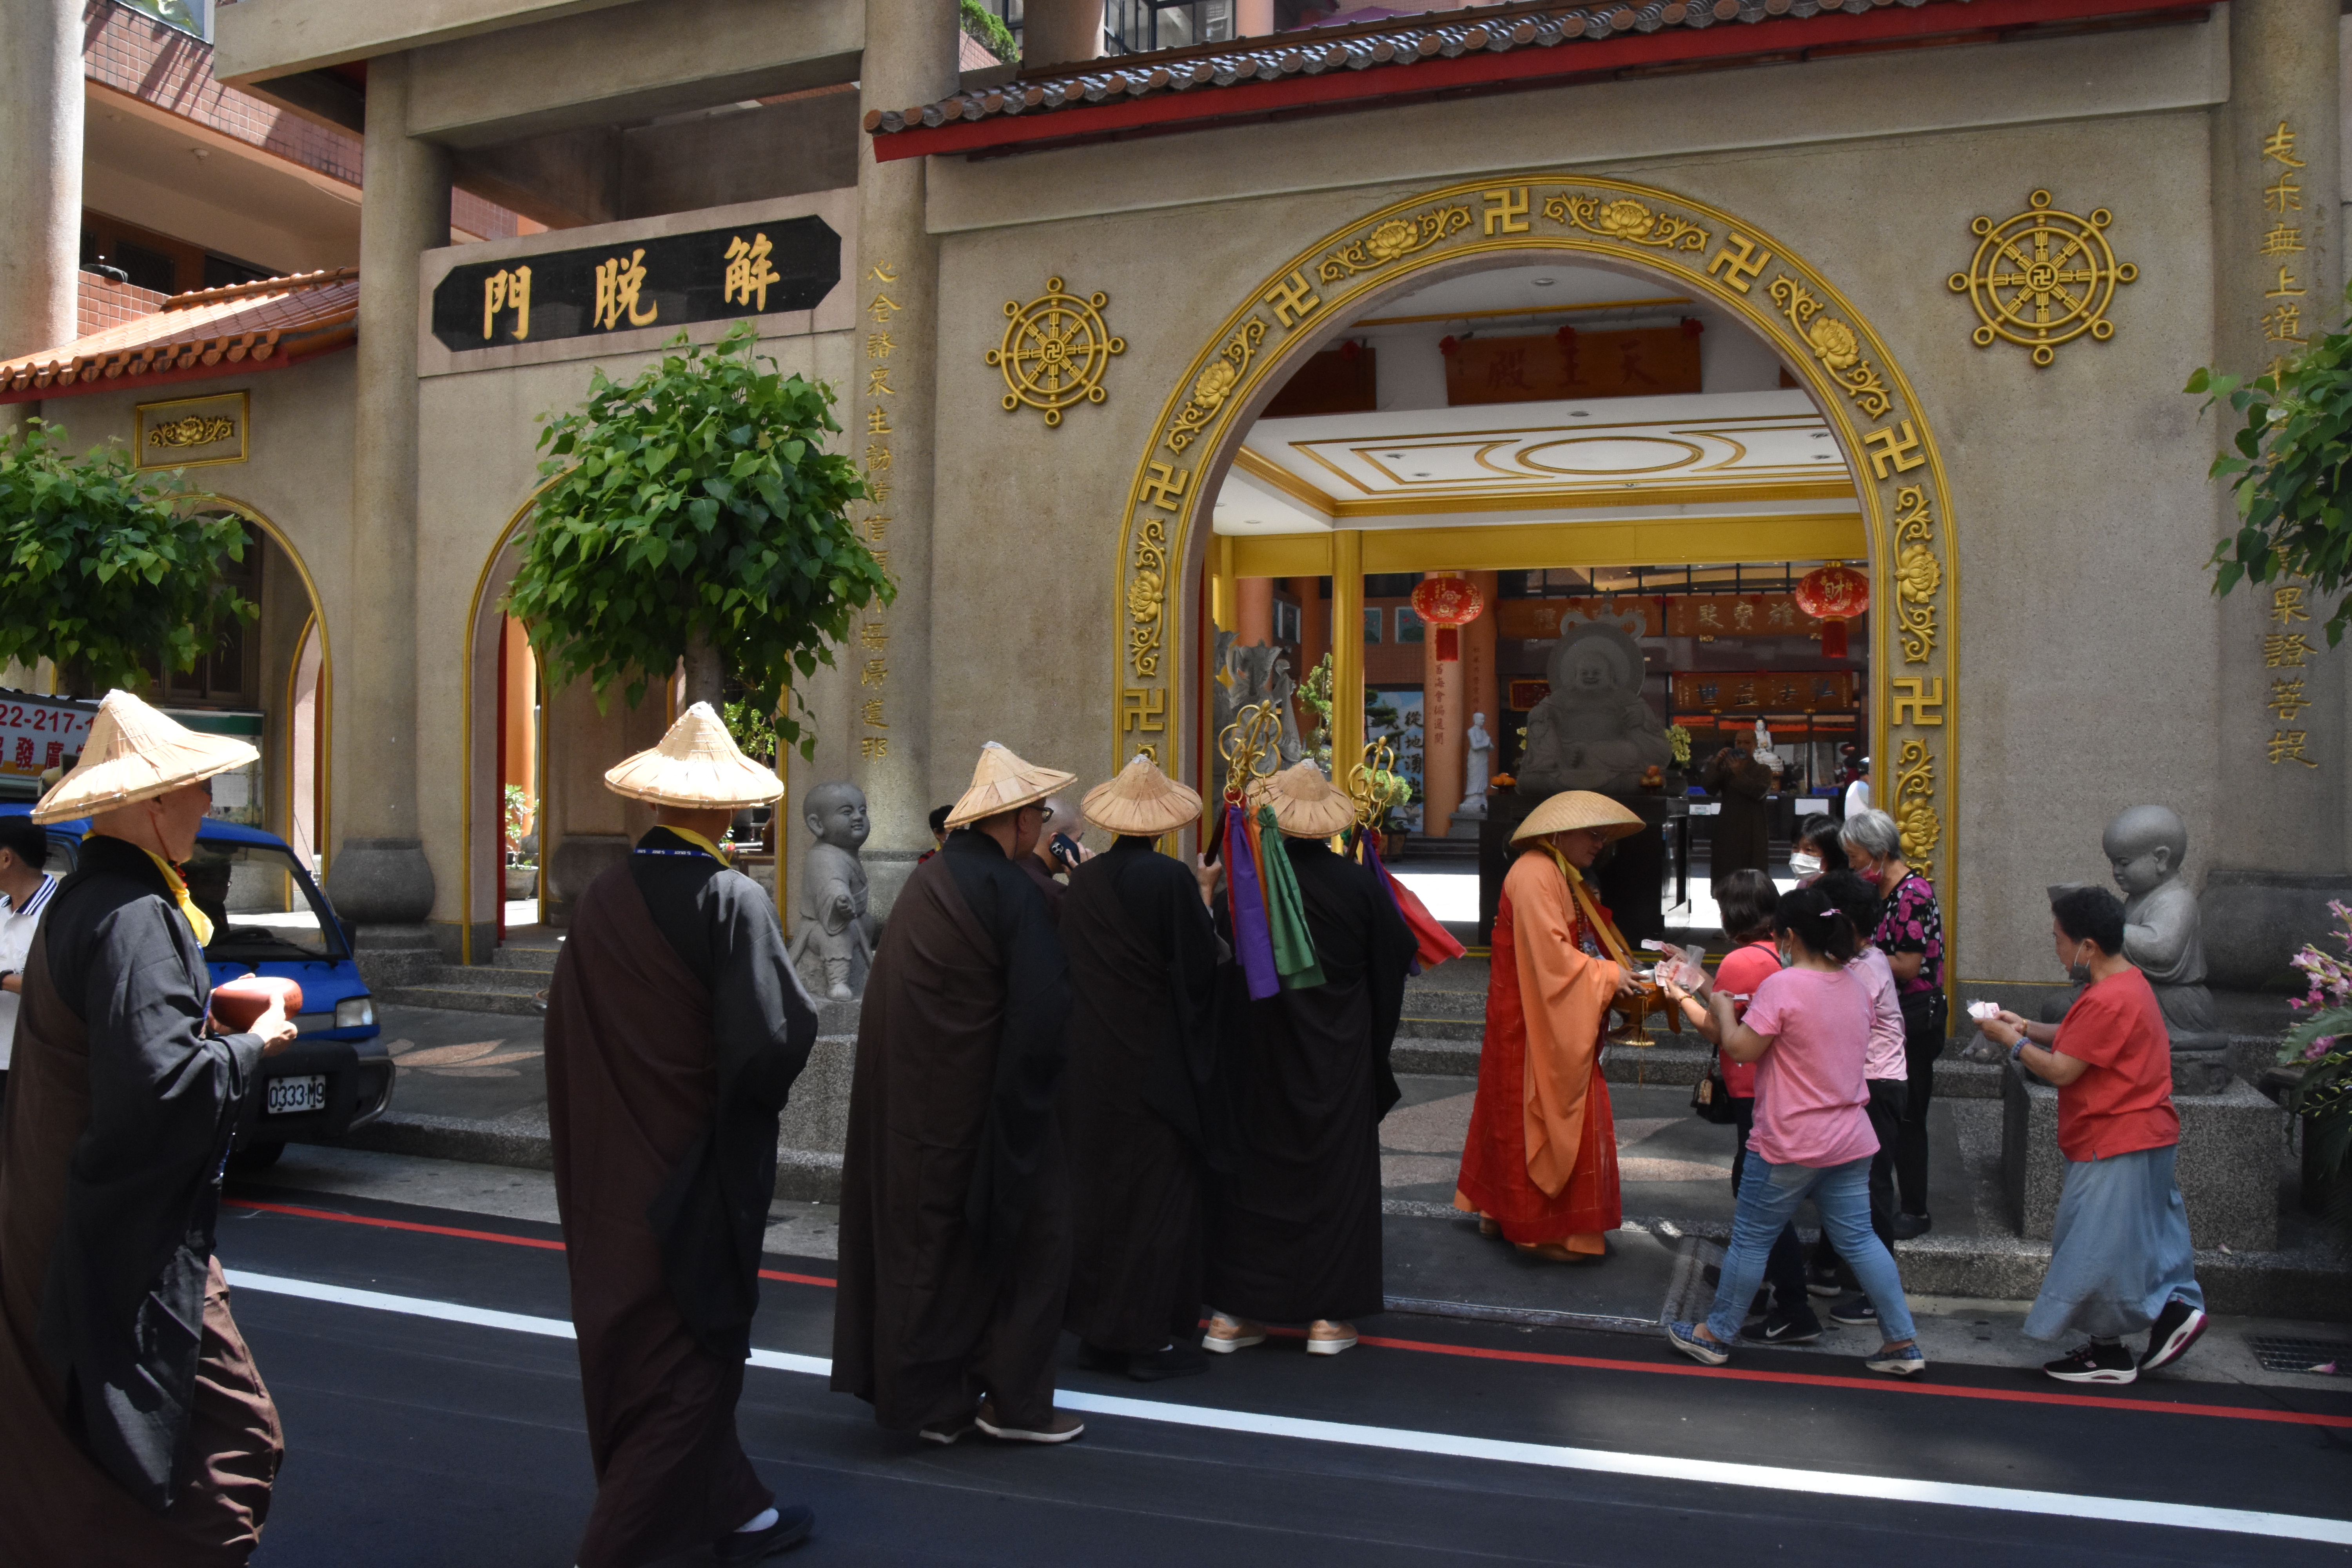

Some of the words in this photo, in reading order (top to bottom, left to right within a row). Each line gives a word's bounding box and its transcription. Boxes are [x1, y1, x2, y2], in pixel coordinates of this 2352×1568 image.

[1487, 339, 1659, 391] 天王殿
[1699, 601, 1823, 630] 雄寶殿
